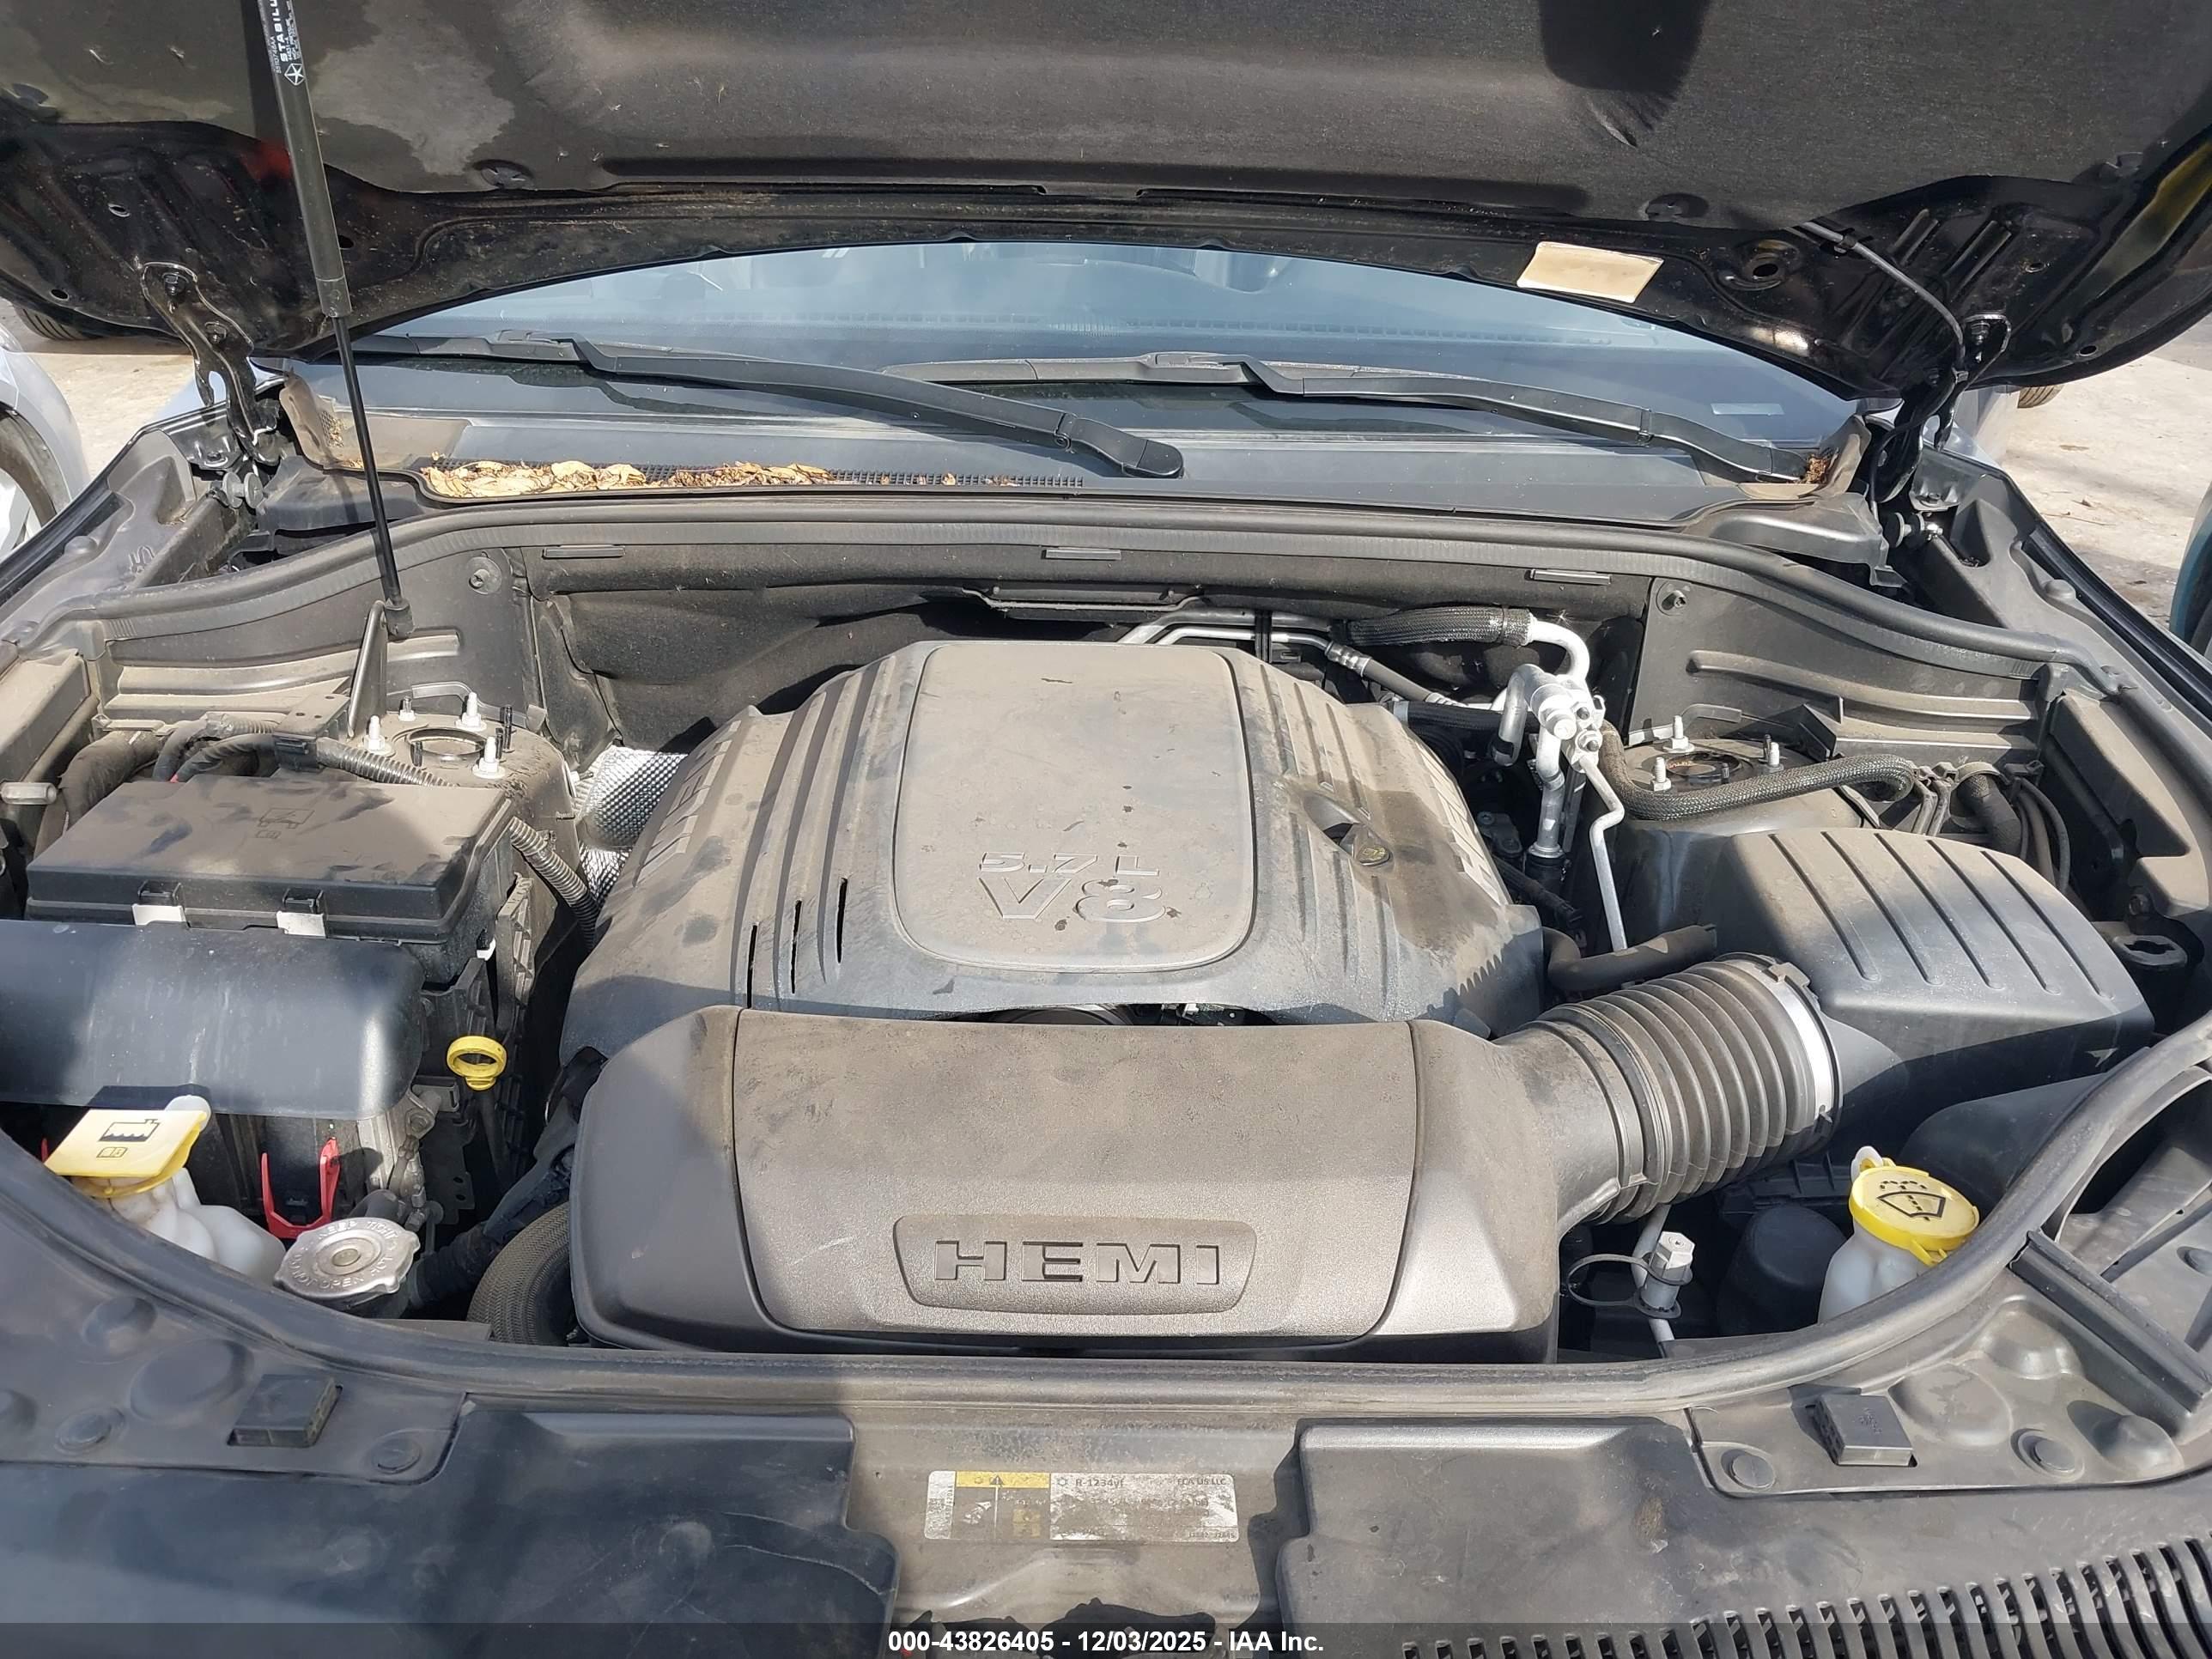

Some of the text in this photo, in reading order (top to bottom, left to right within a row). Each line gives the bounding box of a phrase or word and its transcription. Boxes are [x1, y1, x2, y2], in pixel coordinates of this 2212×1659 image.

[977, 876, 1167, 923] V8
[935, 1239, 1220, 1285] HEMI
[319, 1277, 365, 1289] OPEN
[1075, 1478, 1125, 1488] R-1234yf
